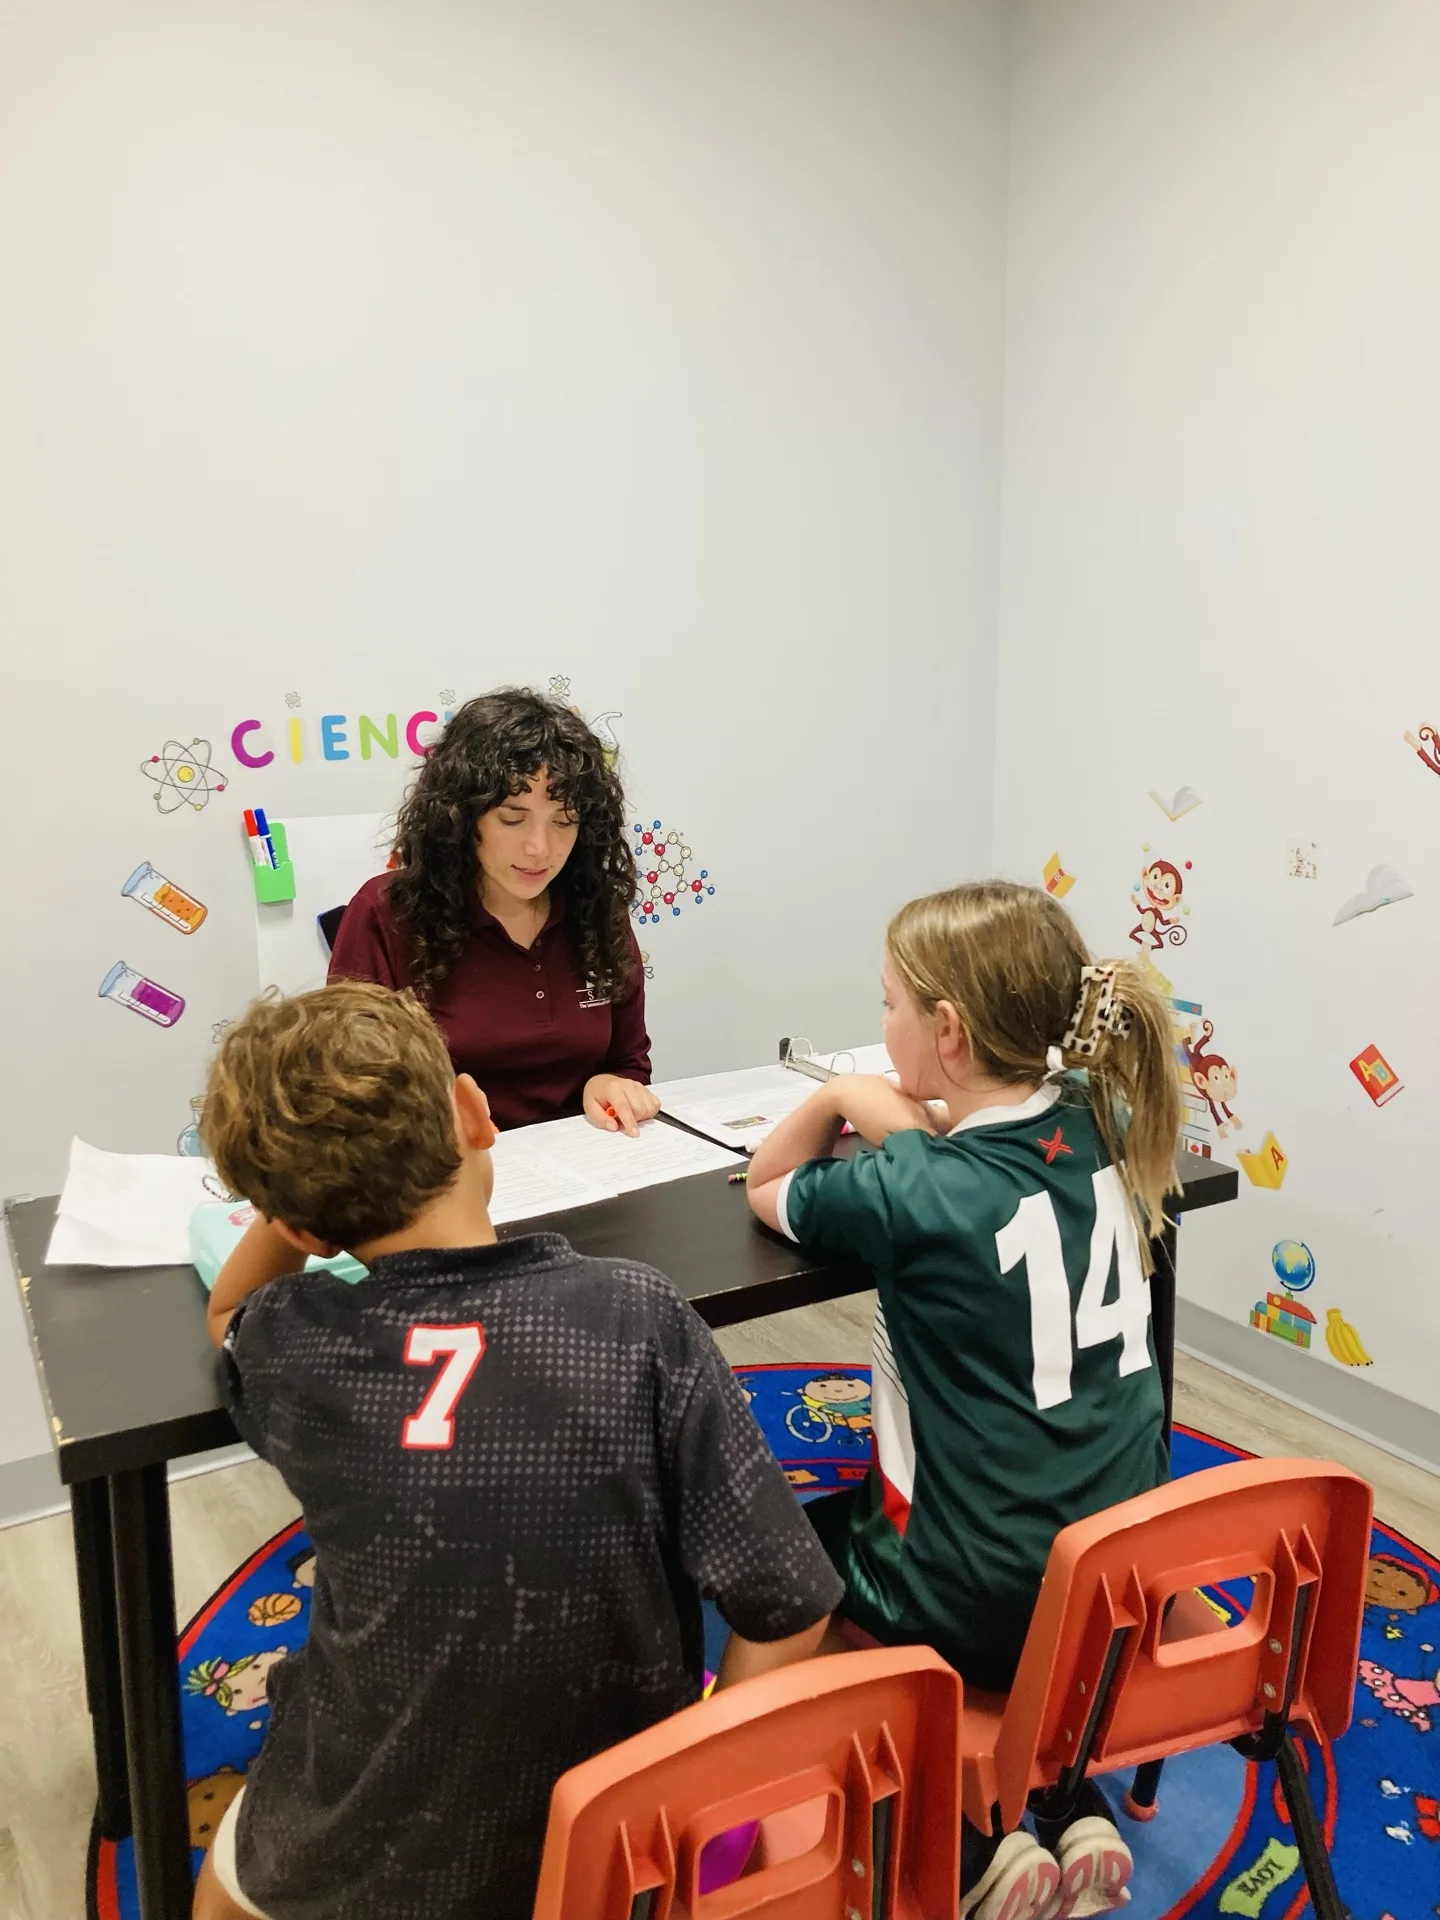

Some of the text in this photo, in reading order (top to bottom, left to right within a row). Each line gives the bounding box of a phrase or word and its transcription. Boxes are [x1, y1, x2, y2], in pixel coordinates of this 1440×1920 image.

[231, 710, 453, 768] CIENC
[1270, 1145, 1285, 1171] A
[995, 1160, 1152, 1410] 14
[401, 1321, 487, 1450] 7
[1237, 1859, 1283, 1897] LOVE
